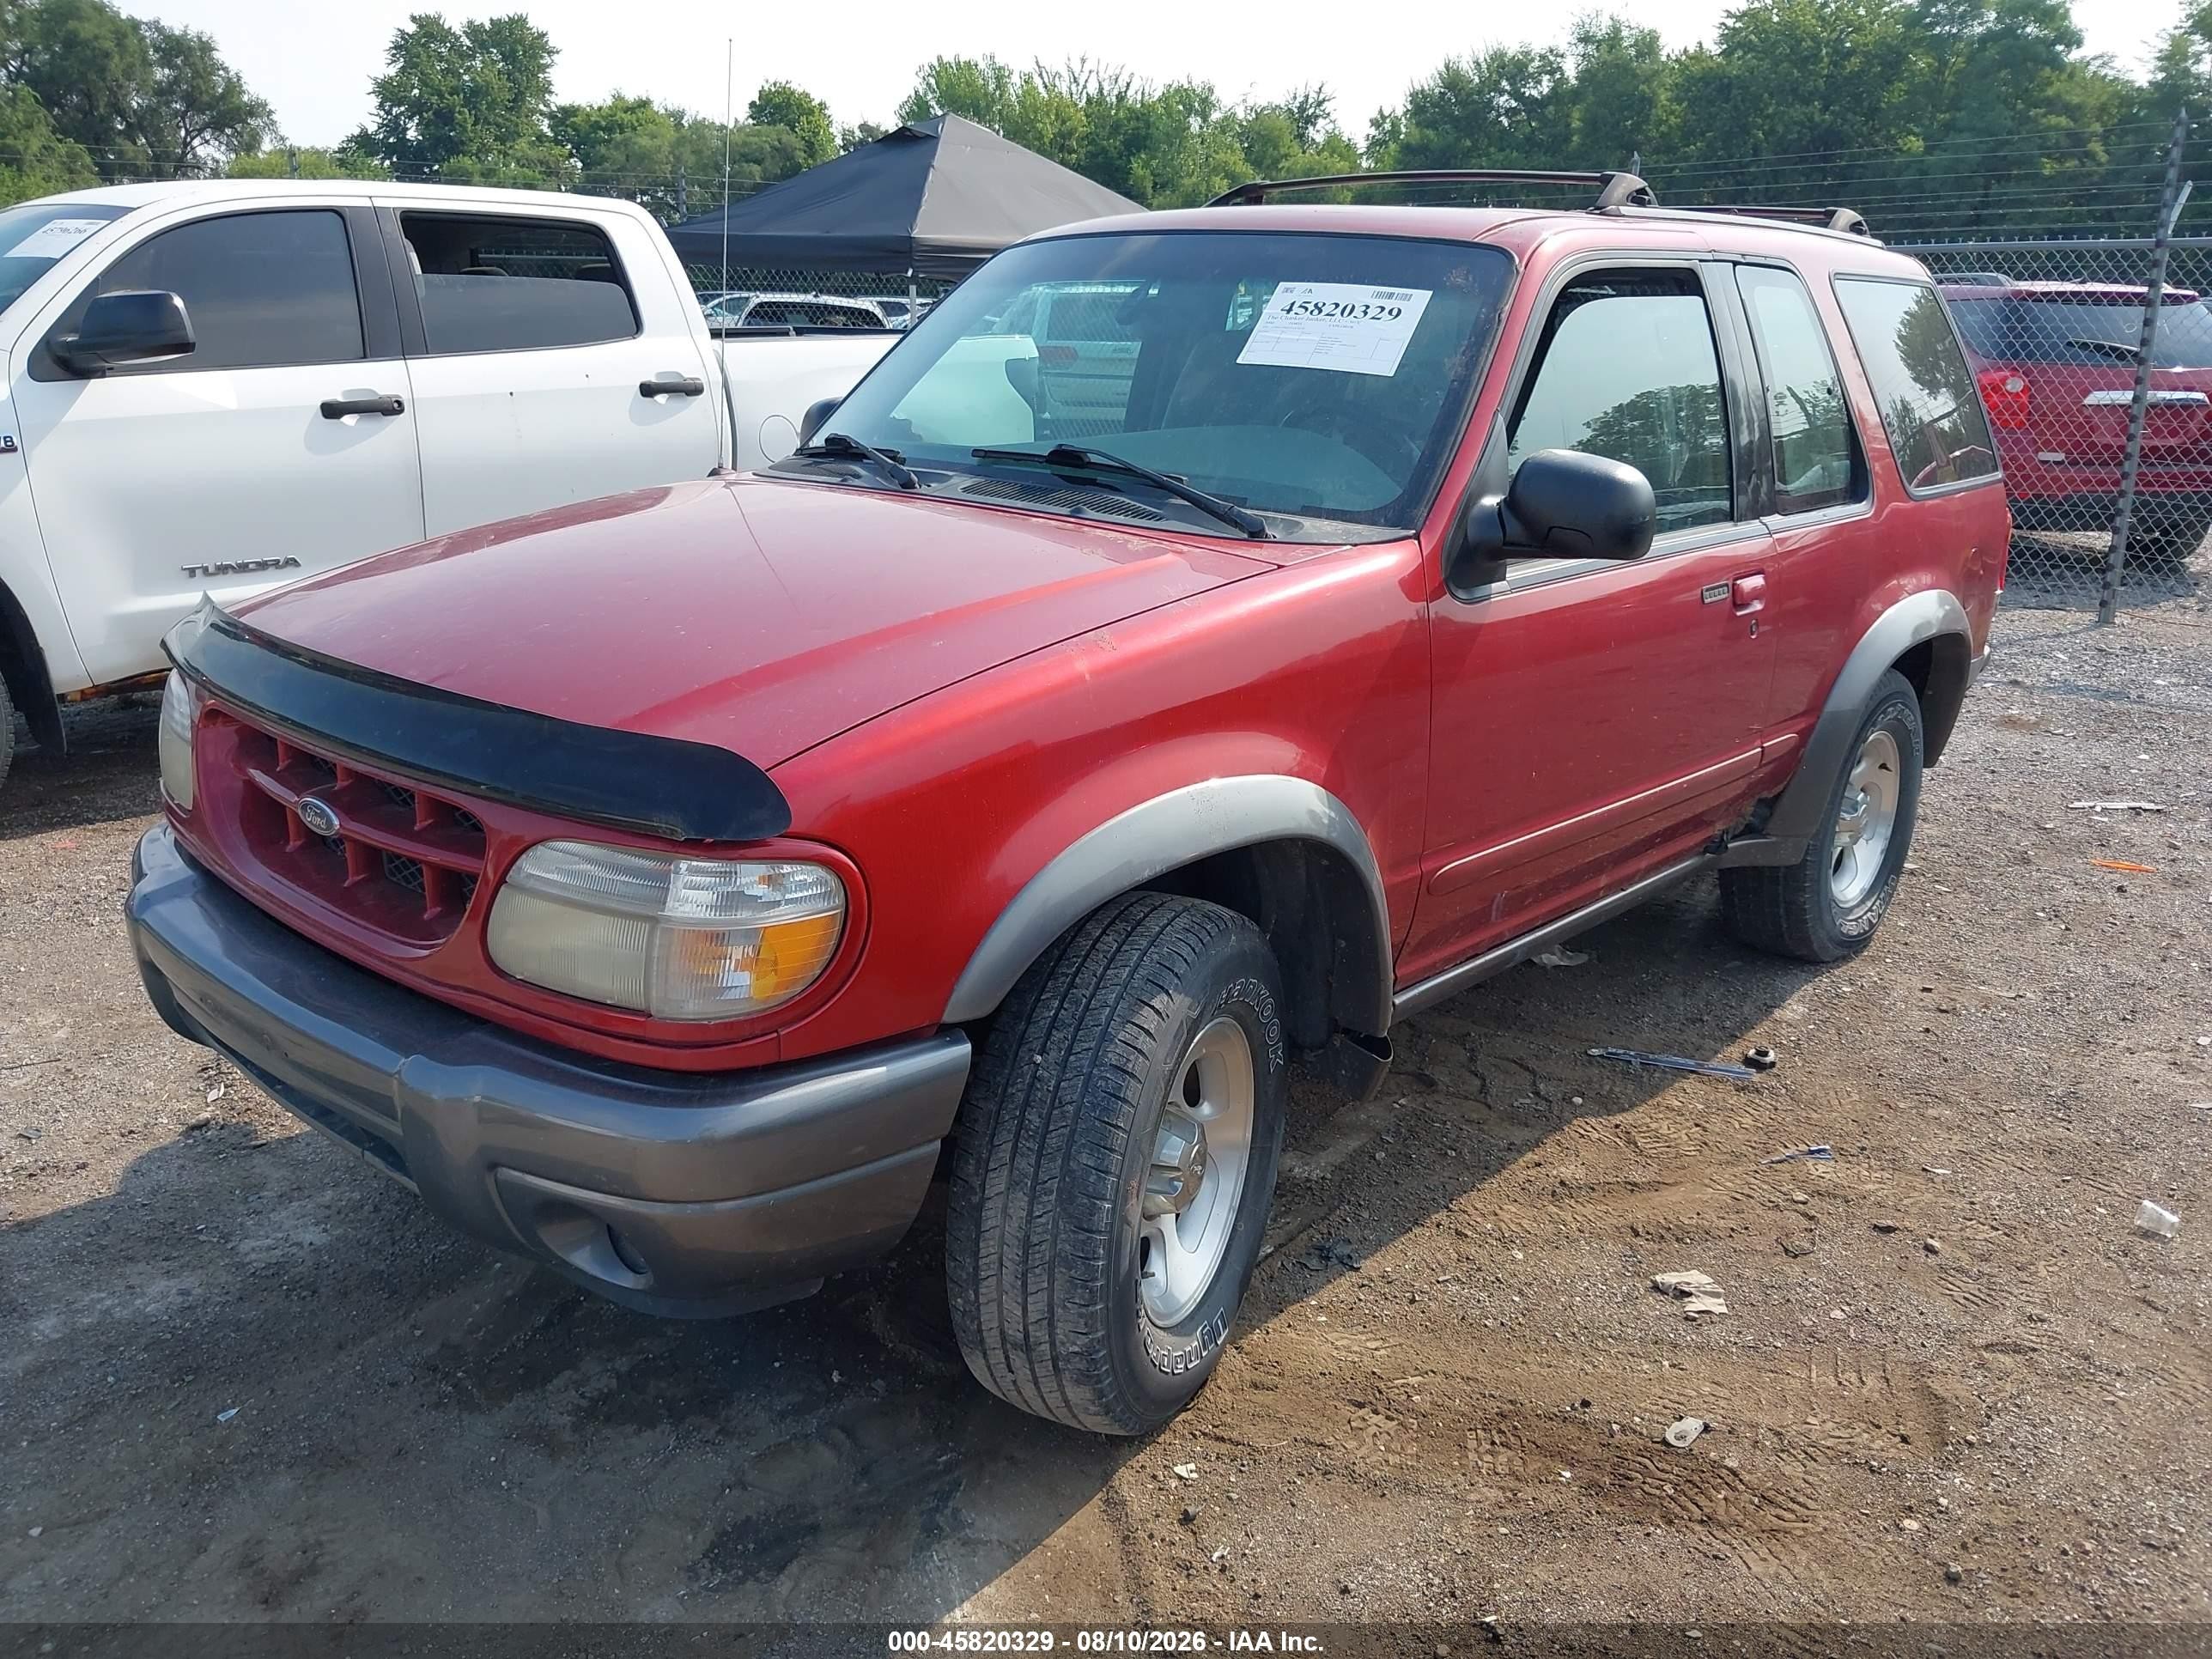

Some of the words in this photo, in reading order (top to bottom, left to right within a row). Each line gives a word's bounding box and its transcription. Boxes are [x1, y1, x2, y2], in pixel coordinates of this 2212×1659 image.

[1280, 301, 1402, 322] 45820329
[0, 435, 15, 447] 8
[181, 555, 301, 578] TUNDRA
[306, 805, 327, 830] Ford
